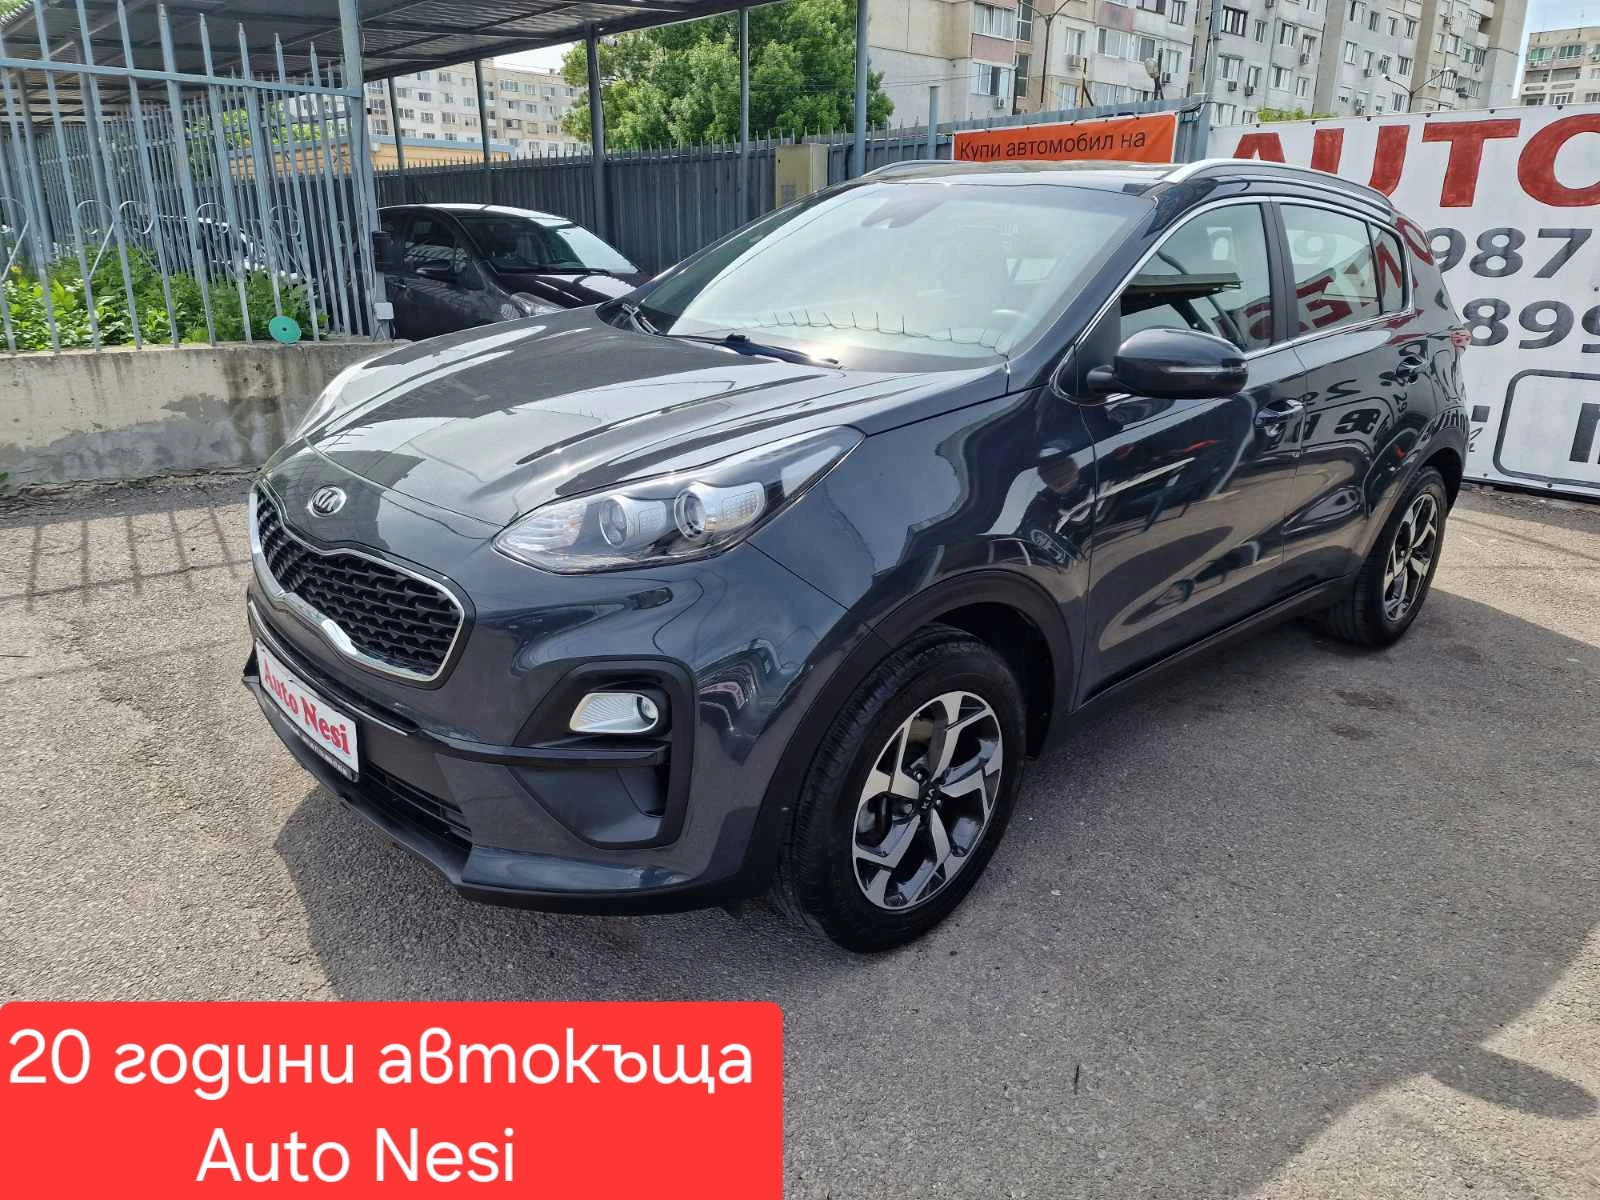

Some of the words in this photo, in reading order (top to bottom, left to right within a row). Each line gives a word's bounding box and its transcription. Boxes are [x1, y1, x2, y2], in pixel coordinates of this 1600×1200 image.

[959, 140, 1001, 160] Купи
[1006, 132, 1114, 158] автомобил
[1120, 130, 1147, 149] на
[263, 658, 299, 715] Auto
[300, 695, 351, 756] Nesi
